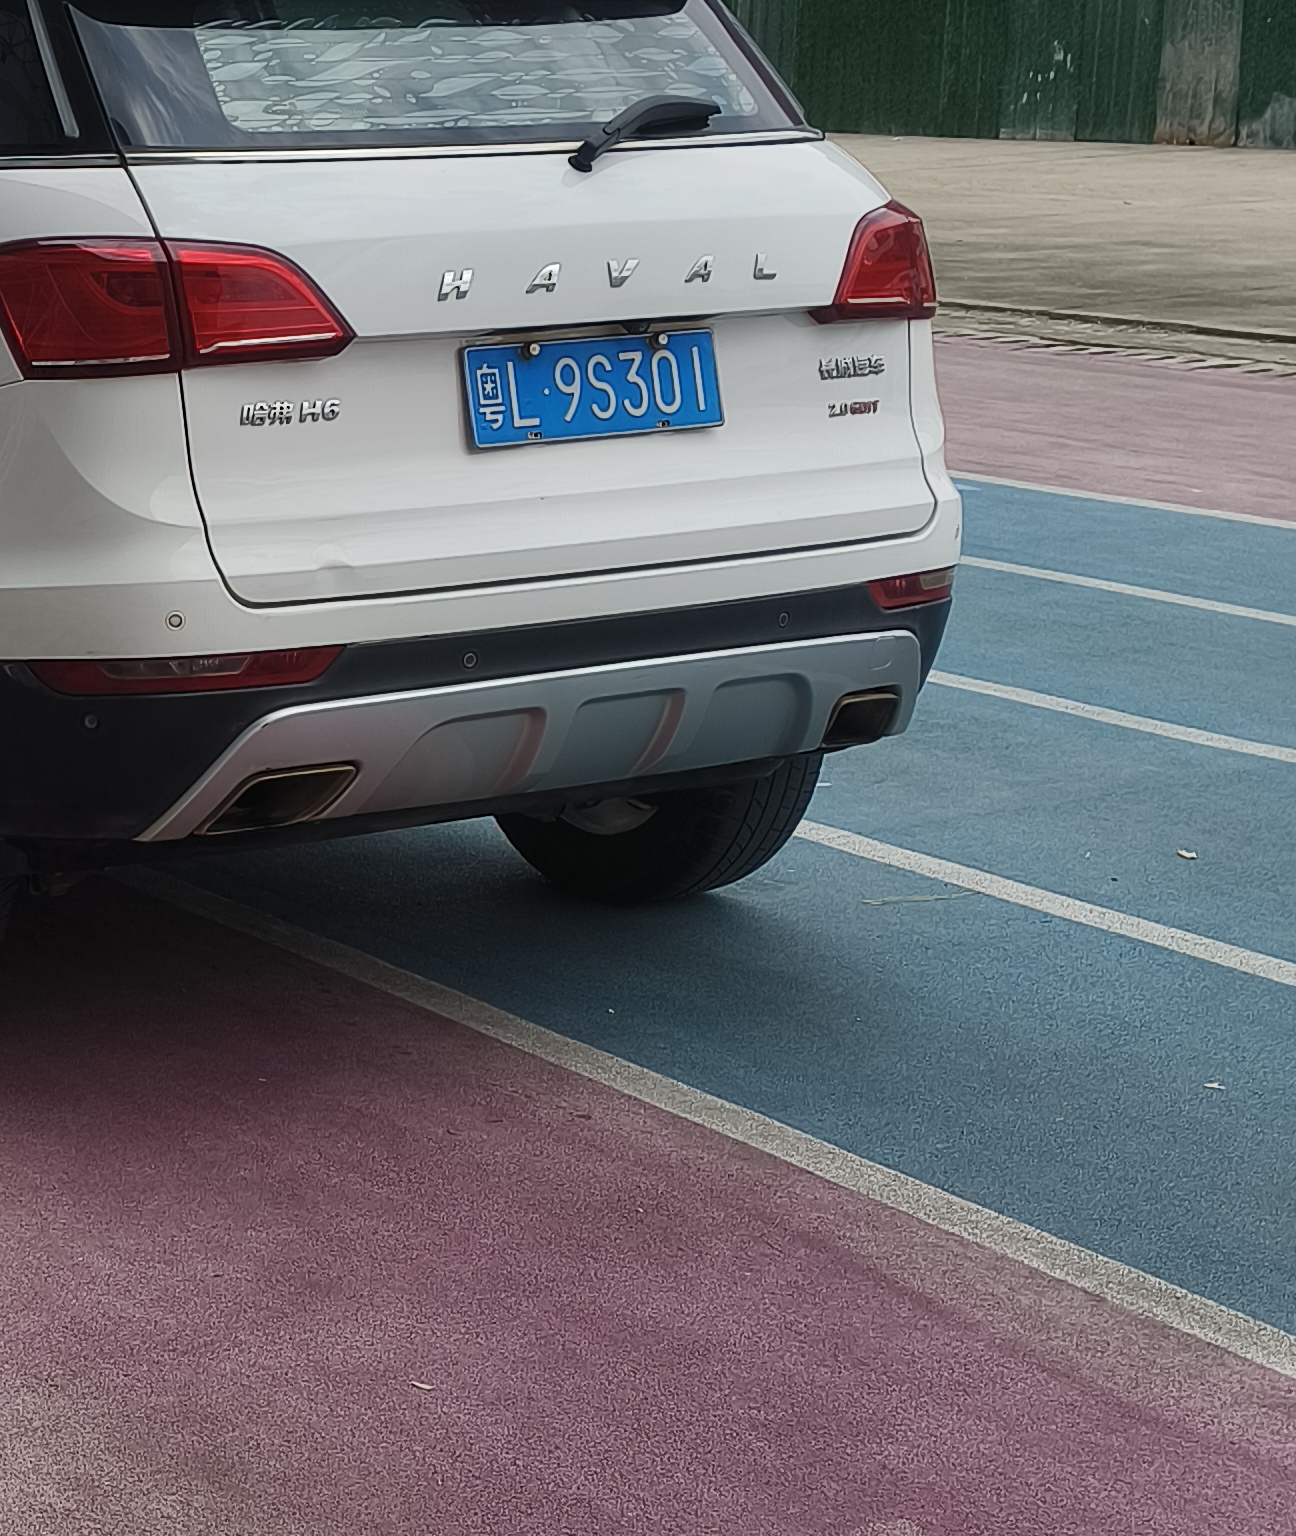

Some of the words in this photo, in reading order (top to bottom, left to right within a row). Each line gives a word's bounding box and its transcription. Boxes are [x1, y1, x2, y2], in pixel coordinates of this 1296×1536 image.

[437, 252, 778, 302] HAVAL
[239, 400, 294, 427] 哈弗
[298, 398, 342, 423] H6
